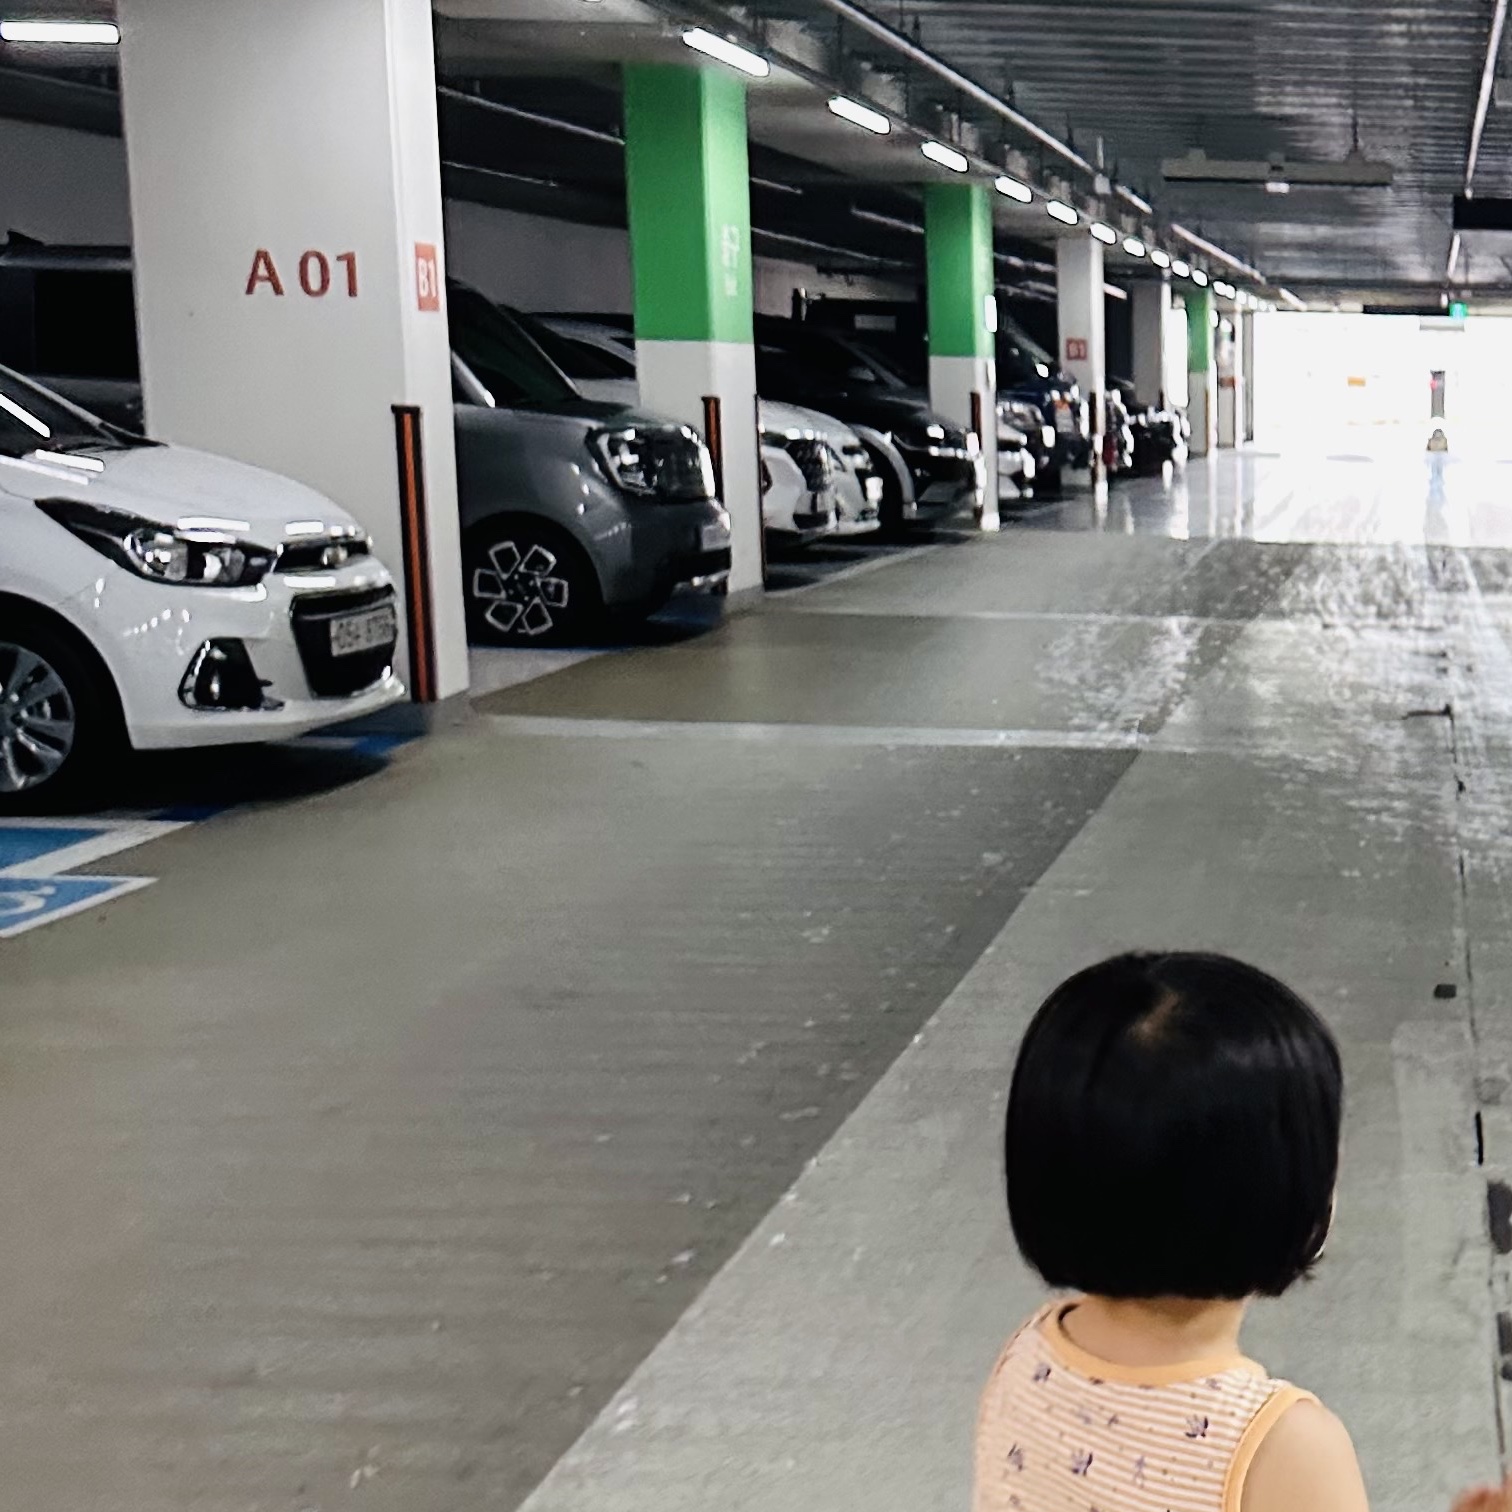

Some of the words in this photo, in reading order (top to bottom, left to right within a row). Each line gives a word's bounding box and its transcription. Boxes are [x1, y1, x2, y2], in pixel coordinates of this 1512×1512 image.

[245, 248, 285, 295] A
[299, 250, 358, 297] 01
[417, 257, 438, 299] B1
